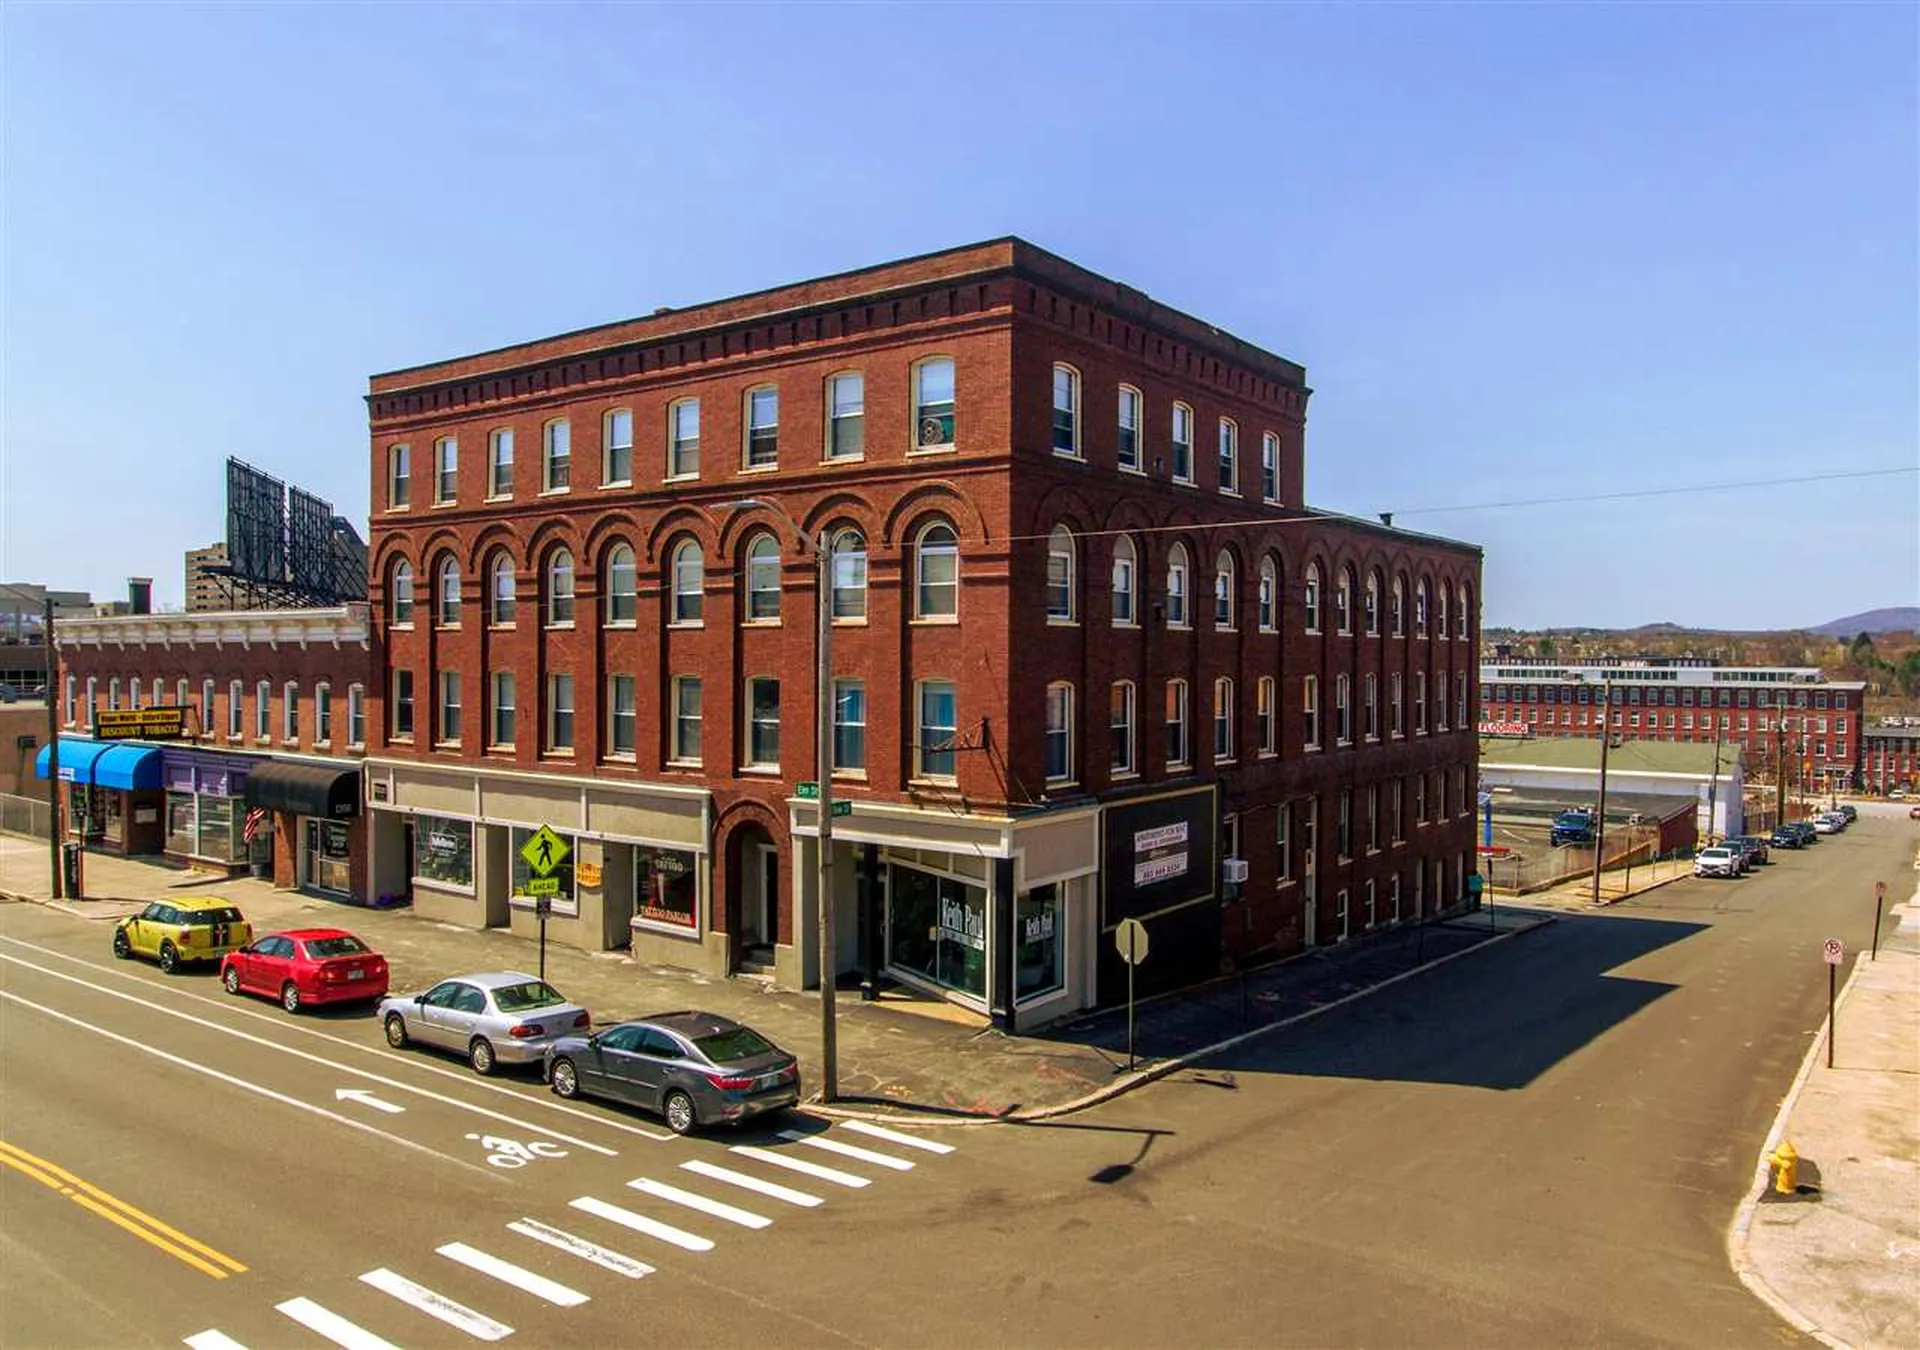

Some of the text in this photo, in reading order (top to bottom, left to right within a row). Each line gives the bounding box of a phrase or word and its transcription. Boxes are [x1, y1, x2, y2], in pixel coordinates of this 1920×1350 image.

[533, 881, 556, 890] AHEAD
[942, 897, 963, 933] Keith
[965, 904, 984, 940] Paul
